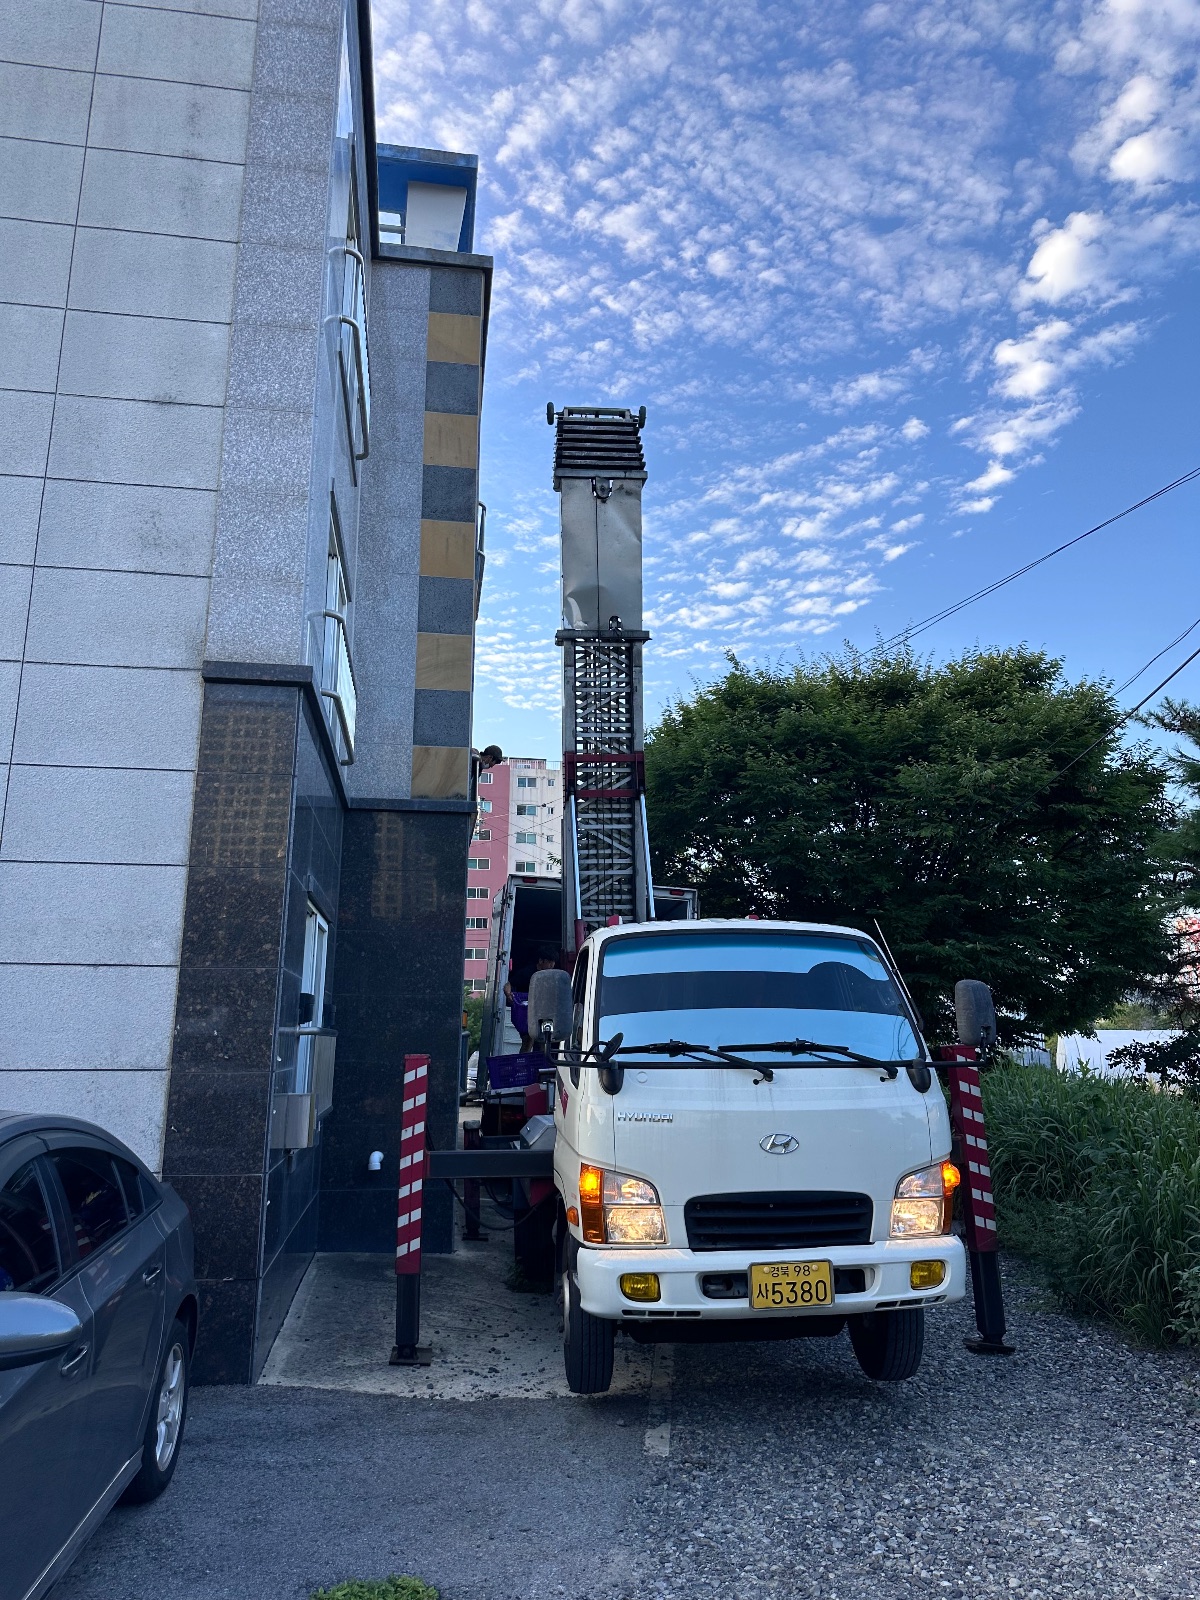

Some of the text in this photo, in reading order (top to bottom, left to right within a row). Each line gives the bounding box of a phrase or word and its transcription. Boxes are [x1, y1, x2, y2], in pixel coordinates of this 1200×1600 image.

[618, 1111, 673, 1123] HYUNDAI
[770, 1265, 811, 1278] 경북 98
